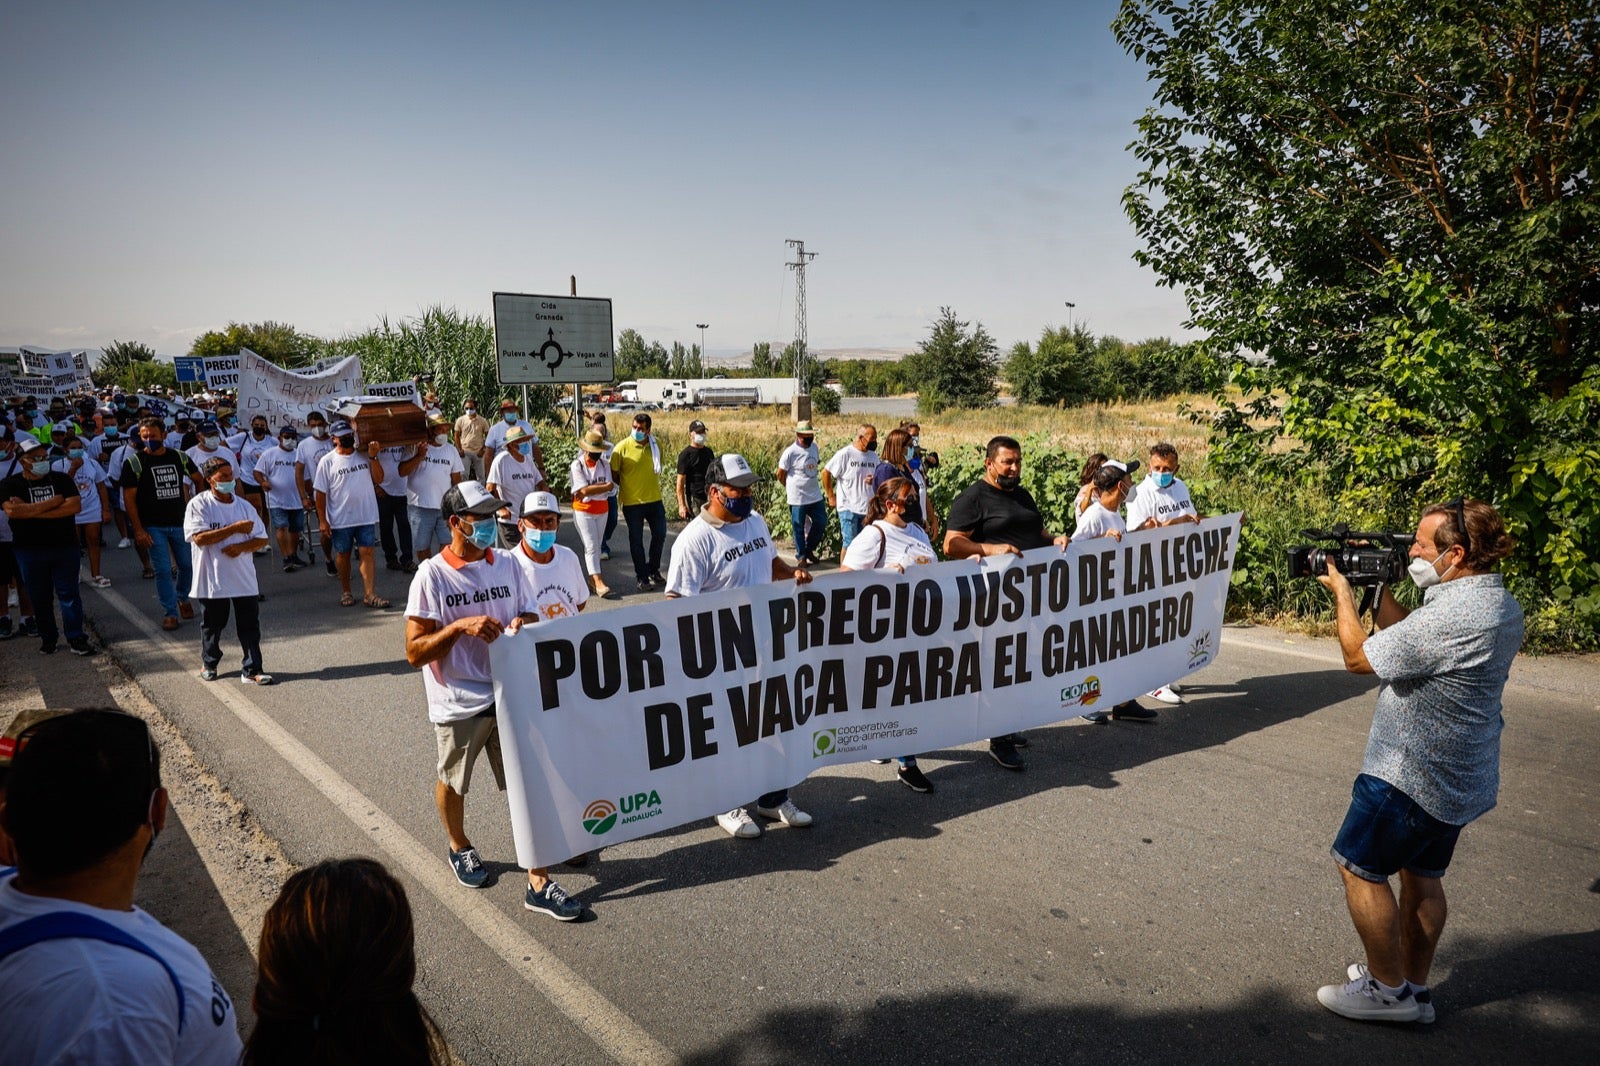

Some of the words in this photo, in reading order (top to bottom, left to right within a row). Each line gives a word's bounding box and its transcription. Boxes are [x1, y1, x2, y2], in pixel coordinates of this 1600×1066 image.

[535, 313, 563, 321] Granada
[577, 352, 595, 361] Vegas
[585, 360, 602, 368] Genil
[210, 374, 239, 387] JUSTO
[369, 385, 414, 398] PRECIOS
[338, 468, 351, 477] OPL
[359, 463, 370, 472] SUR
[1158, 503, 1172, 514] OPL
[724, 546, 743, 562] OPL
[743, 542, 753, 554] del
[753, 537, 767, 550] SUR
[446, 593, 471, 608] OPL
[473, 587, 489, 602] del
[491, 585, 511, 600] SUR
[535, 622, 665, 711] POR
[677, 604, 757, 679] UN
[768, 577, 944, 662] PRECIO
[953, 559, 1070, 632] JUSTO
[1078, 550, 1116, 607] DE
[1124, 543, 1156, 596] LA
[1161, 526, 1232, 588] LECHE
[644, 692, 719, 771] DE
[727, 658, 849, 747] VACA
[862, 641, 982, 710] PARA
[993, 634, 1032, 689] EL
[1041, 591, 1194, 678] GANADERO
[1062, 680, 1098, 700] COAG
[837, 721, 899, 736] cooperativas
[837, 727, 918, 745] agro-alimentarias
[620, 790, 662, 814] UPA
[621, 808, 662, 824] ANDALUCÍA
